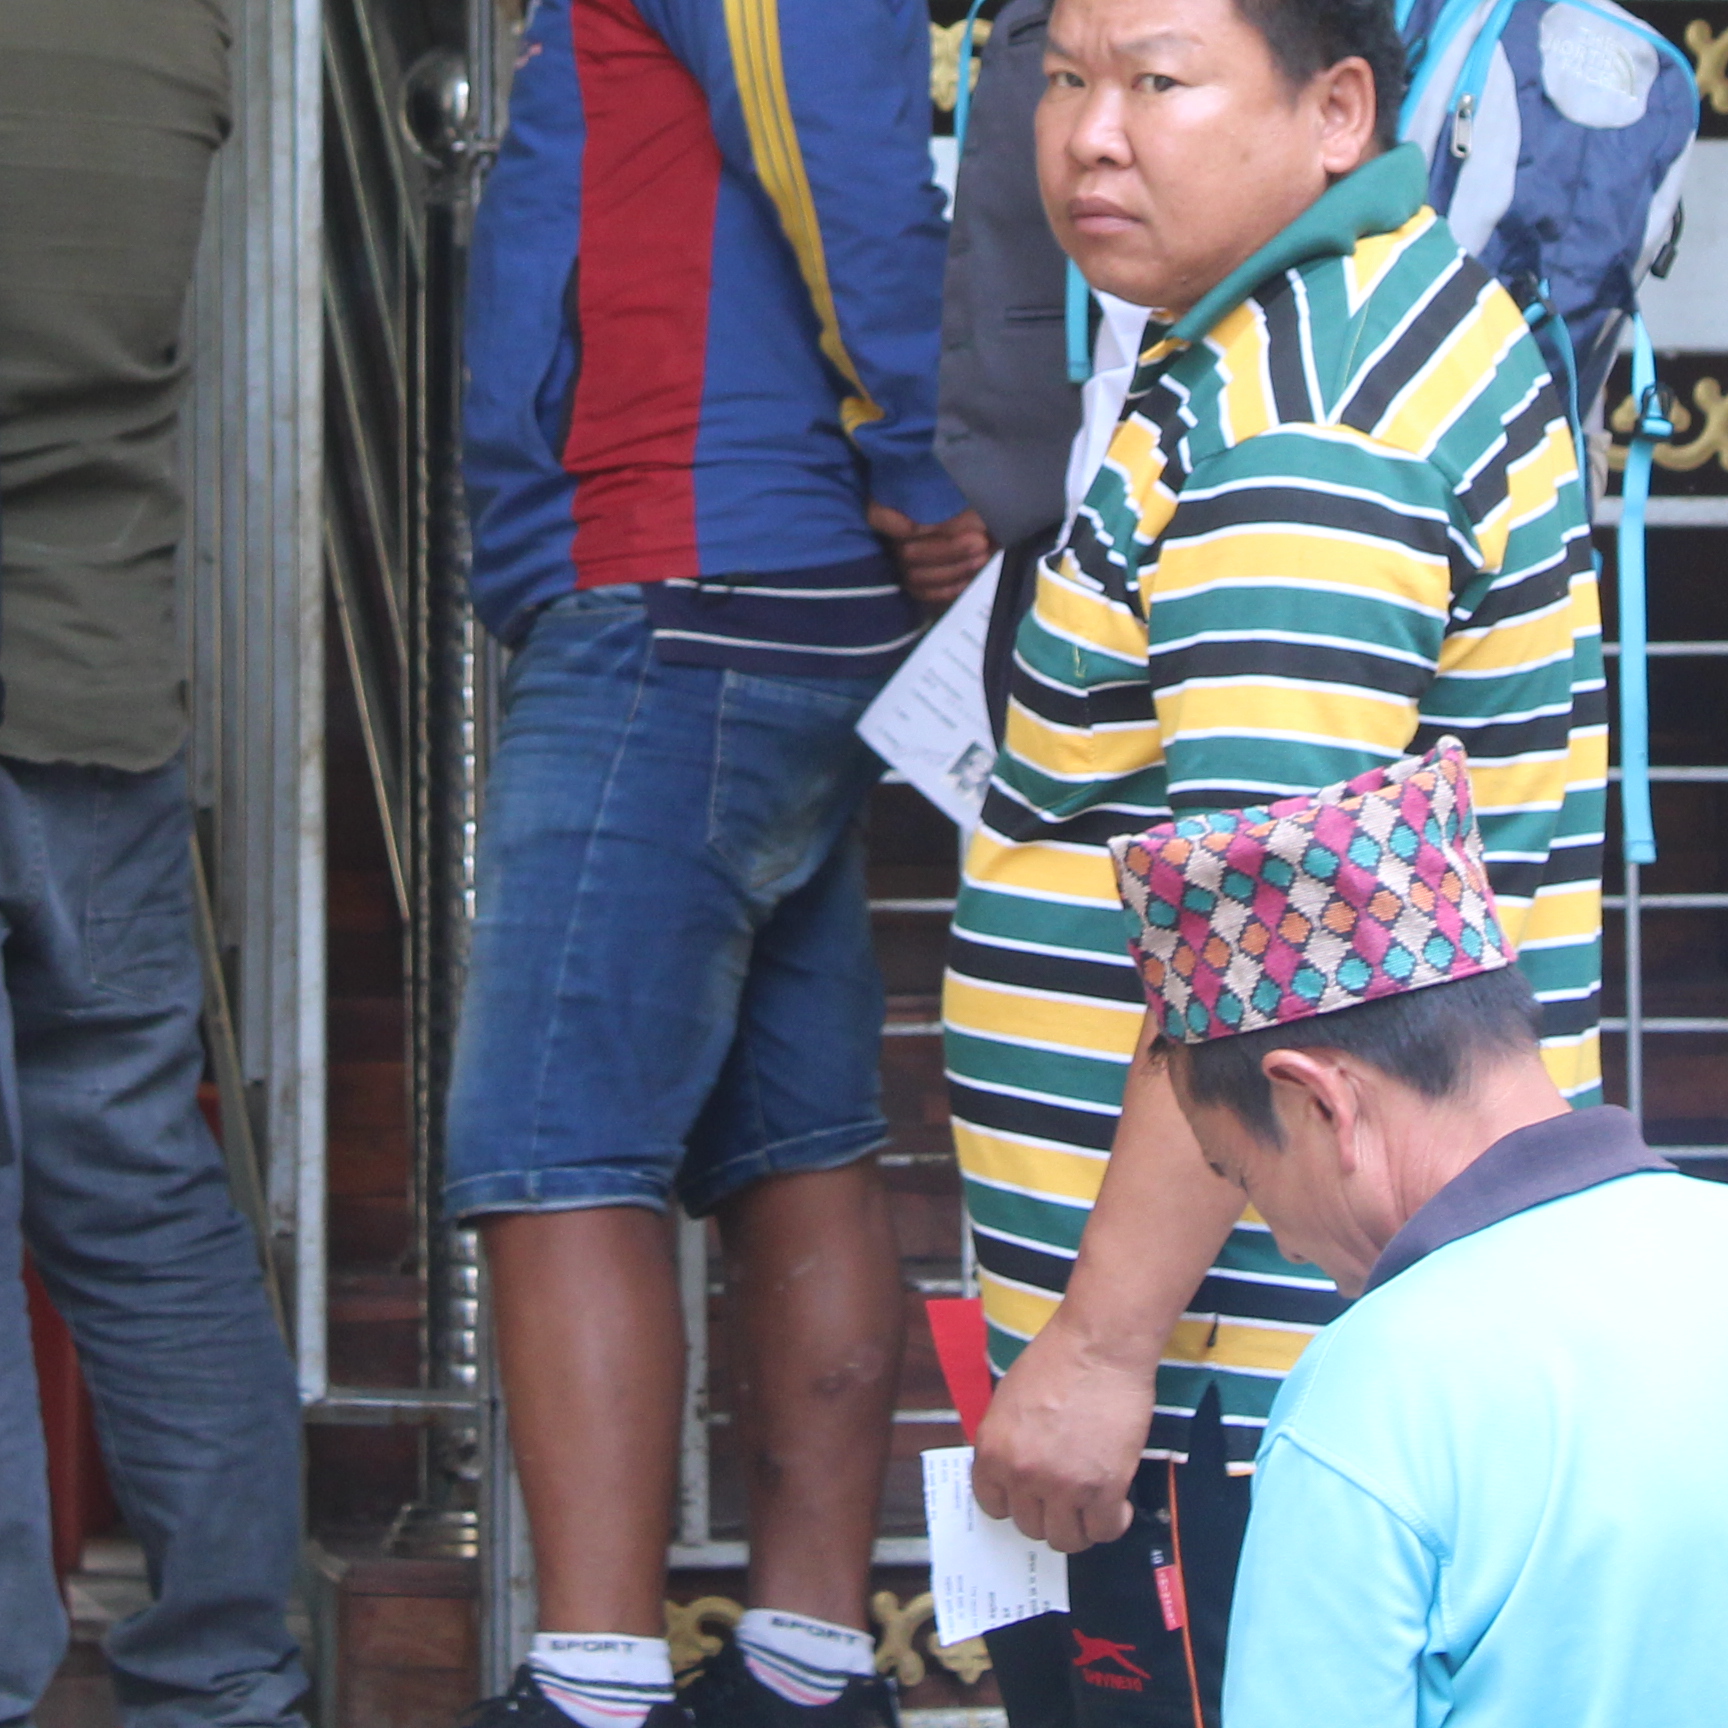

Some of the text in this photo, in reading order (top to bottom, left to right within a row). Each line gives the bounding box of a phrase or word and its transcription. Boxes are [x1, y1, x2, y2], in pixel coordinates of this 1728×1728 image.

[1545, 35, 1615, 68] NORTH
[771, 1617, 860, 1645] SPORT
[550, 1639, 640, 1654] SPORT
